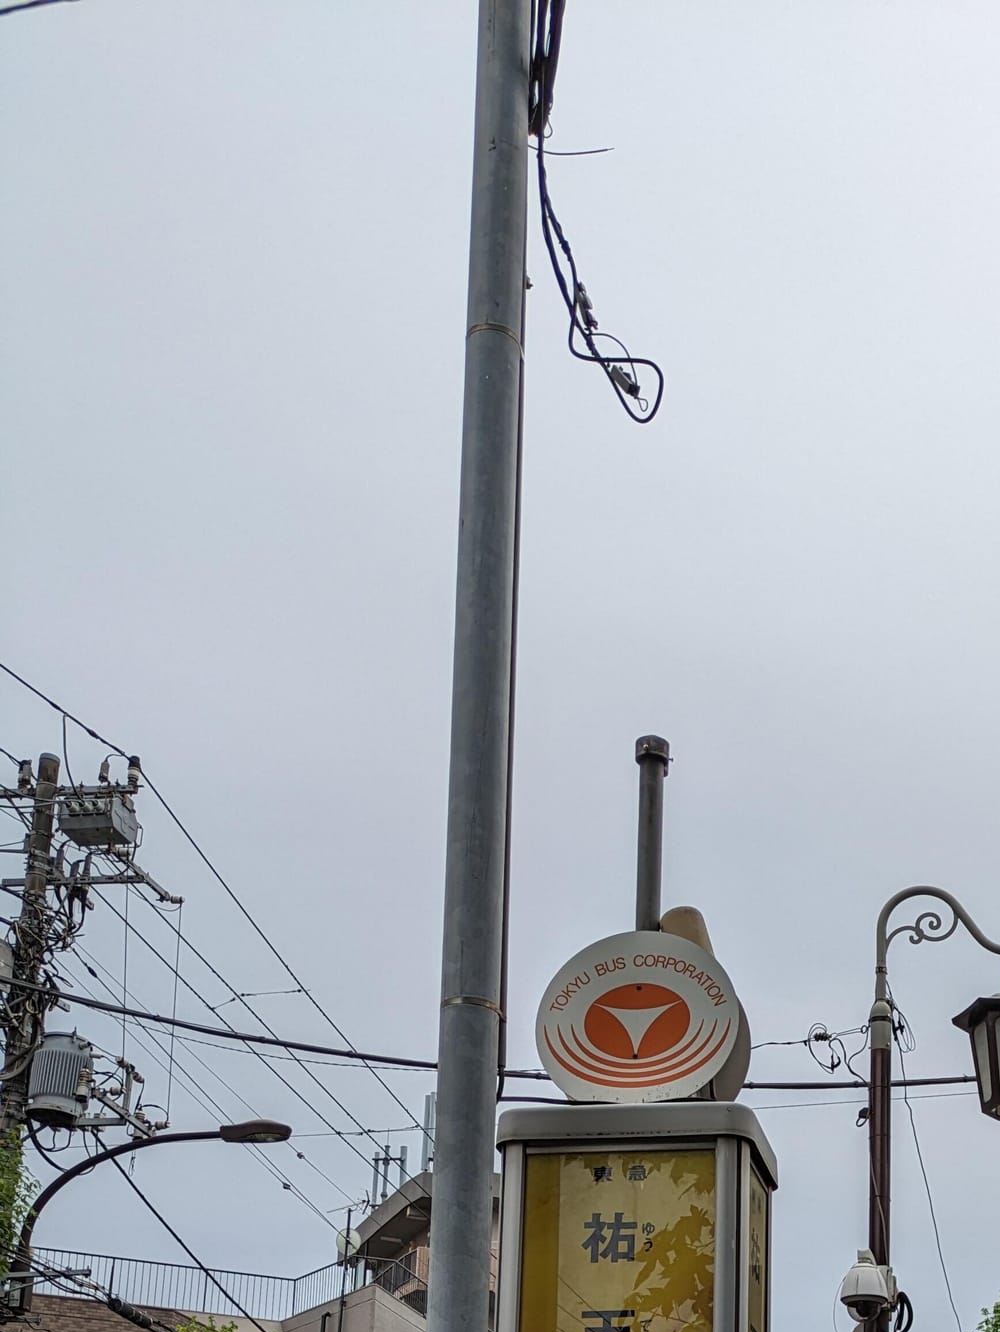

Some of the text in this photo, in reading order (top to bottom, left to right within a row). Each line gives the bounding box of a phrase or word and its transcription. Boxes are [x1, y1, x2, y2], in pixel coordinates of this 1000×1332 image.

[549, 954, 728, 1013] TOKYU BUS CORPORATION
[592, 1164, 648, 1182] 東急
[641, 1222, 656, 1253] ゆう
